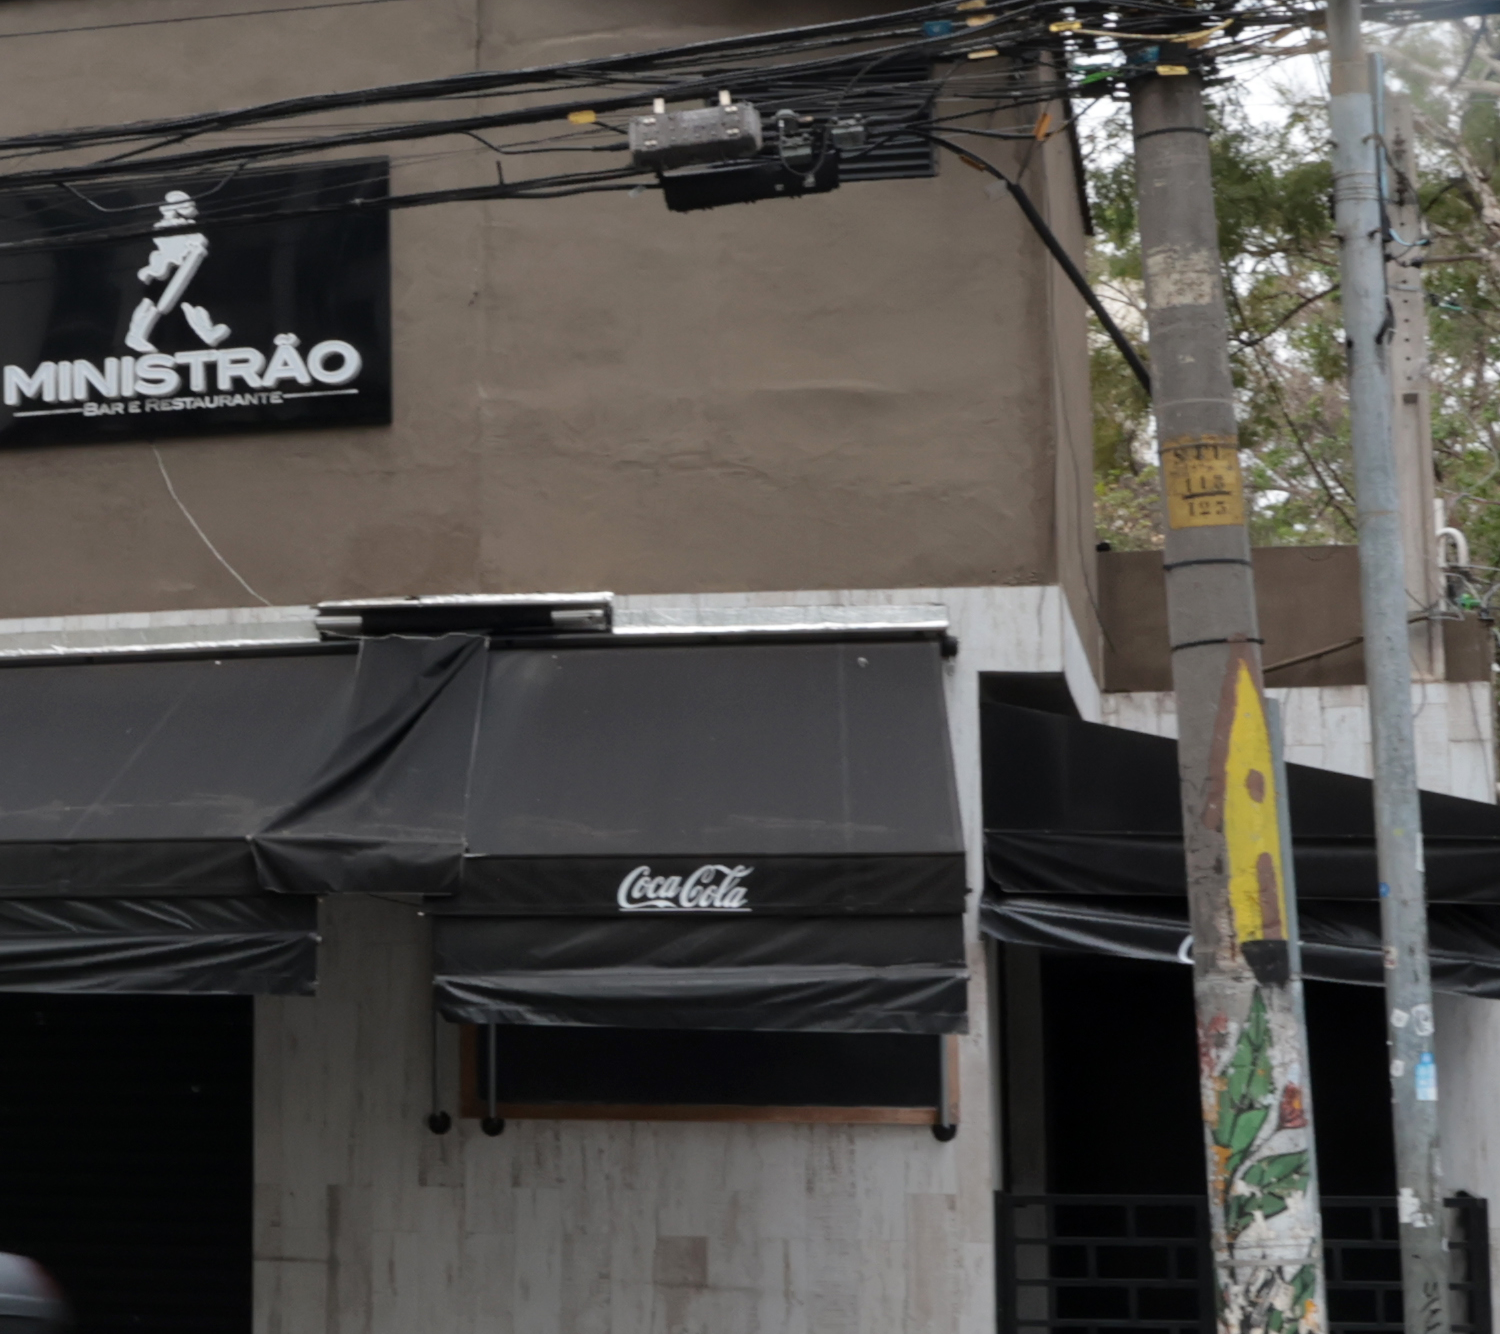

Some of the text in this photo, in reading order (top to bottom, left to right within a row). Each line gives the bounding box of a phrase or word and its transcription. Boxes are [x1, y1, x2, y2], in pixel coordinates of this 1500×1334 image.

[3, 333, 362, 406] MINISTRÃO
[83, 390, 283, 417] BAR E RESTAURANTE
